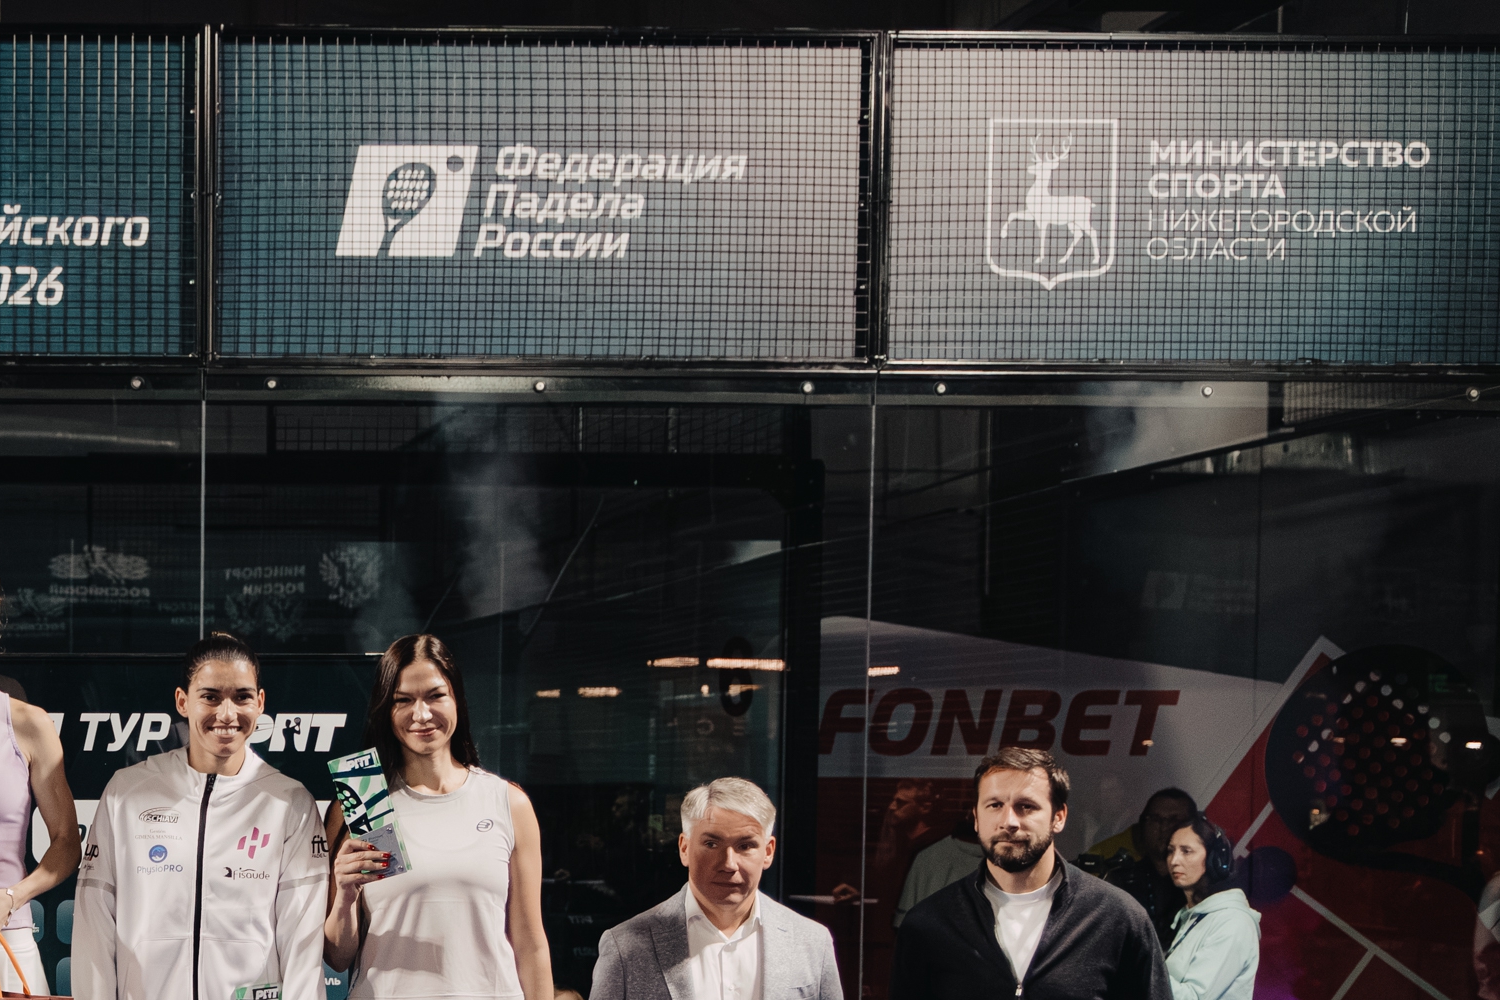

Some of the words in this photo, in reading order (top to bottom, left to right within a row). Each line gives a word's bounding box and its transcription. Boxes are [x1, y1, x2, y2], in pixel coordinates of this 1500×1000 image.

[496, 143, 748, 186] Федерация
[1151, 140, 1430, 168] МИНИСТЕРСТВО
[1148, 172, 1286, 199] СПОРТА
[483, 183, 645, 223] Падела
[1148, 206, 1416, 238] НИЖЕГОРОДСКОЙ
[473, 223, 630, 258] России
[1147, 237, 1285, 261] ОБЛАСТИ
[79, 713, 171, 752] ТУР
[818, 689, 1180, 757] FONBET
[136, 864, 183, 876] PhysioPRO
